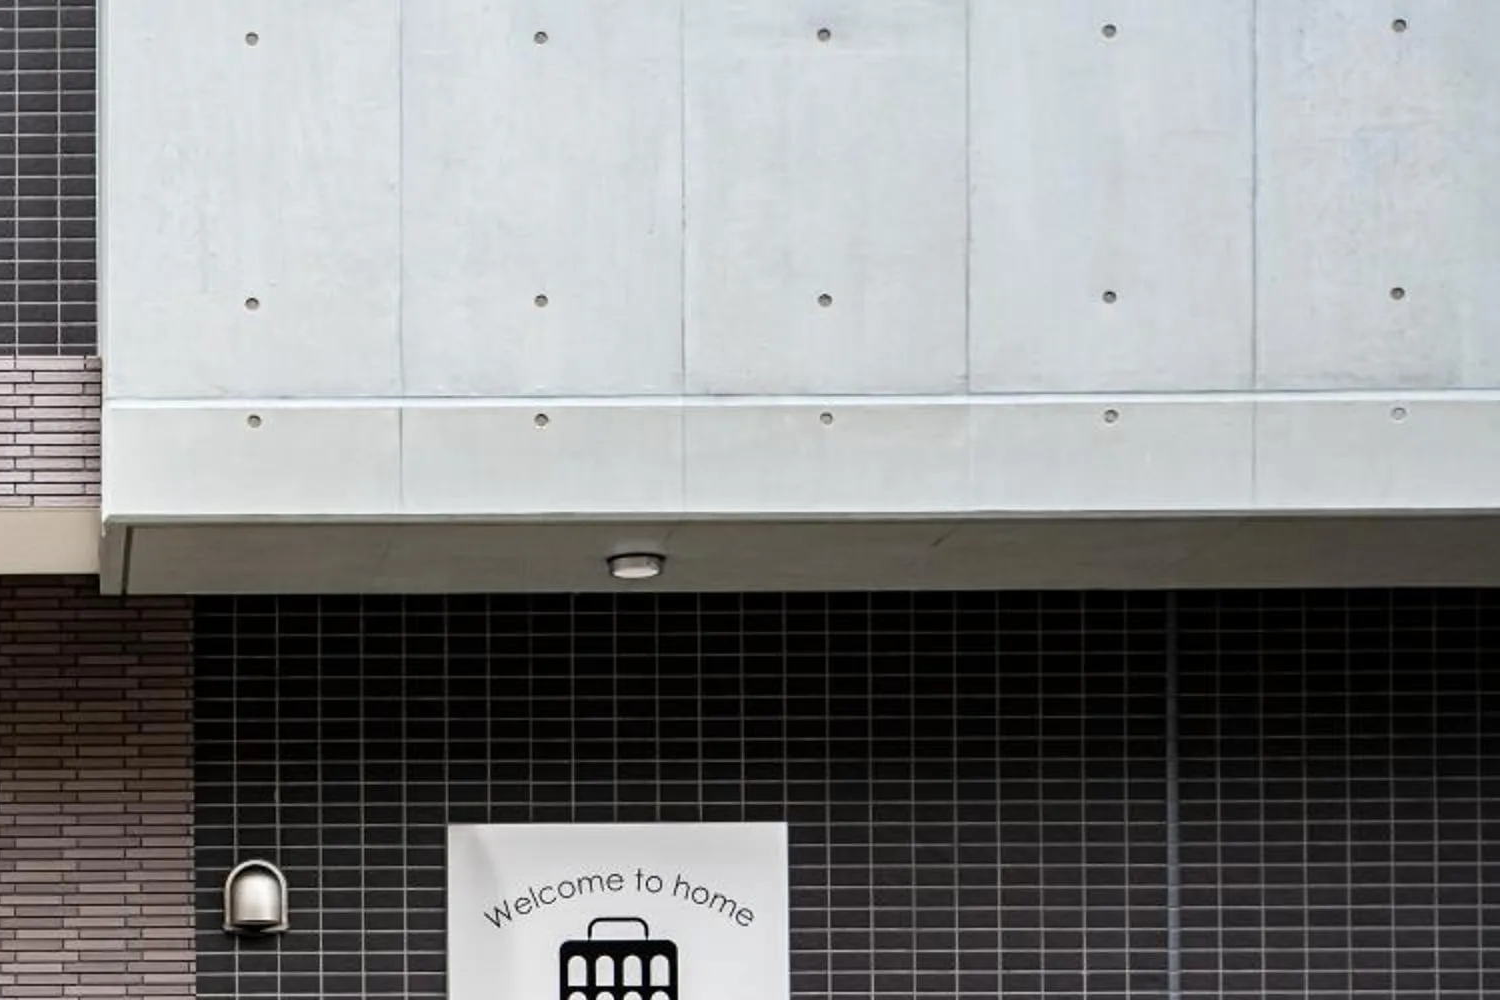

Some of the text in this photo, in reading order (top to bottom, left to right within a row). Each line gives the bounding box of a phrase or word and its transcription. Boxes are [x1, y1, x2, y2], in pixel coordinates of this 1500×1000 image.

[483, 867, 756, 929] Welcome to home
